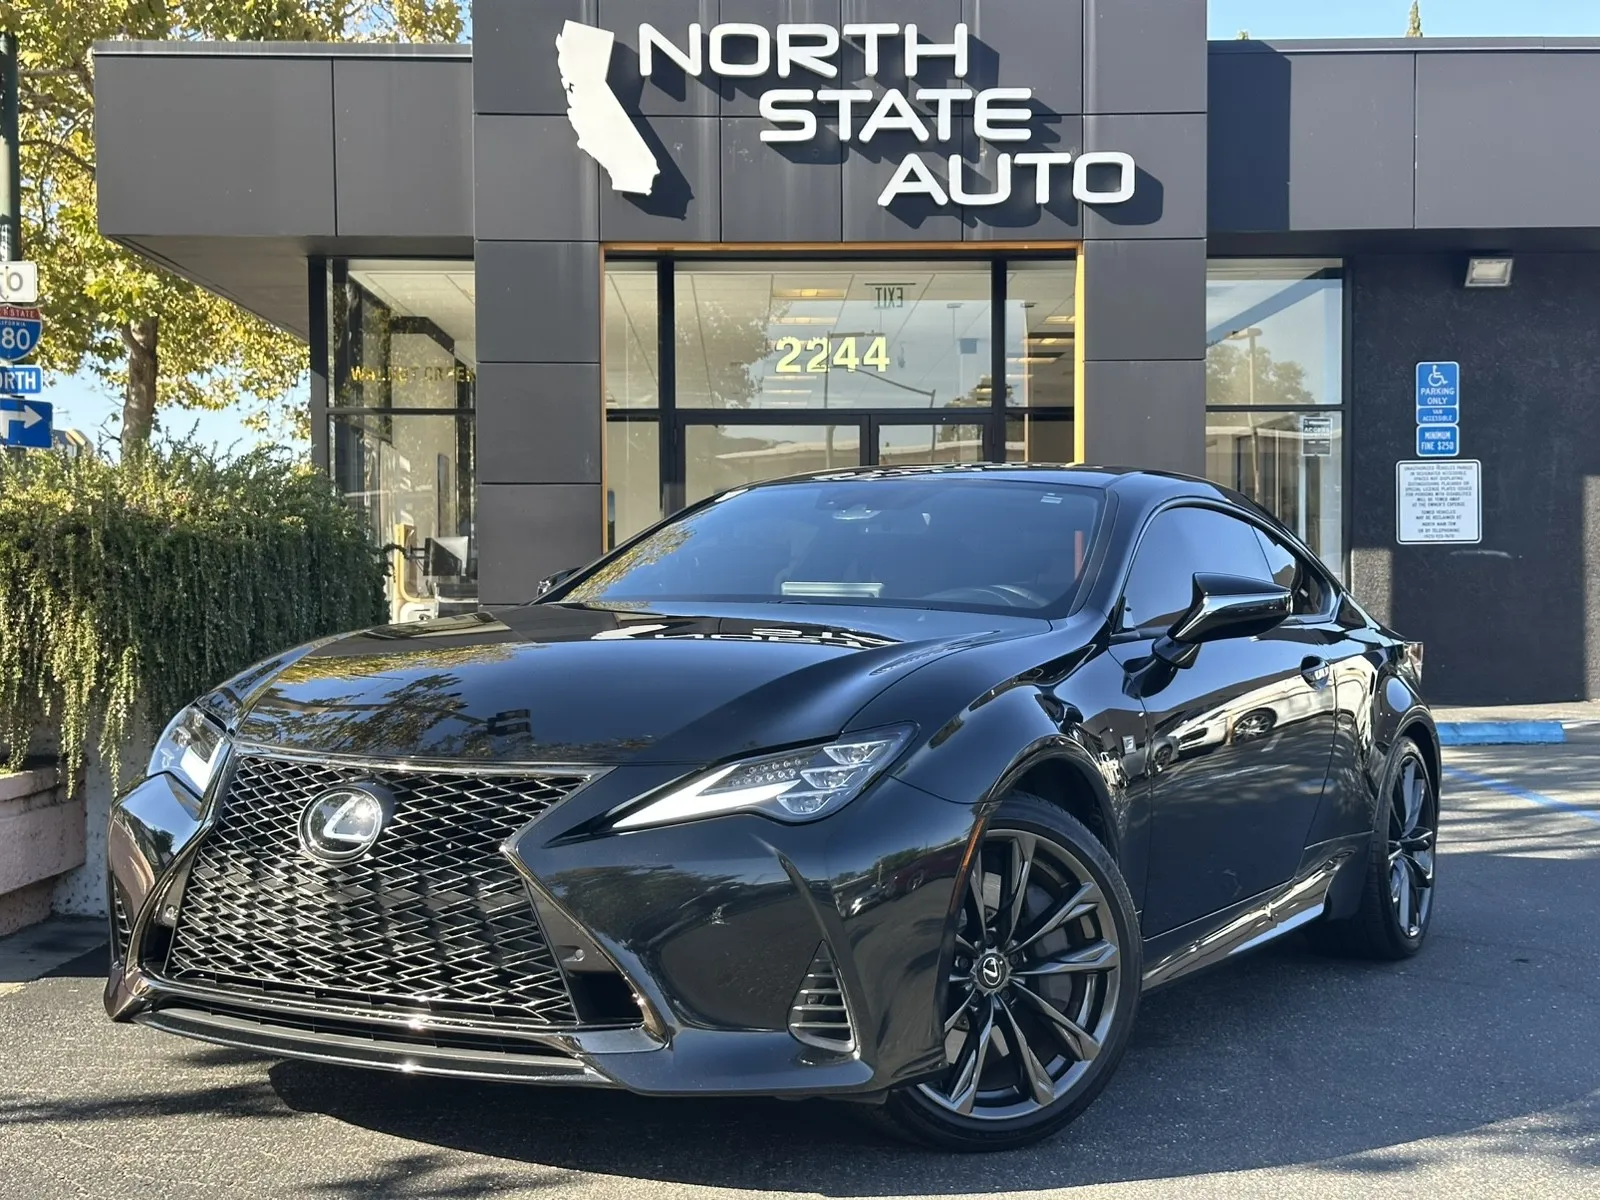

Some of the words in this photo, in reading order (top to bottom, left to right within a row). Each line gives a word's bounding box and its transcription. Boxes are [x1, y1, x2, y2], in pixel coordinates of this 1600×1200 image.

[638, 22, 968, 78] NORTH
[758, 87, 1032, 143] STATE
[877, 151, 1136, 207] AUTO
[775, 335, 890, 374] 2244
[1421, 441, 1435, 450] FINE
[1437, 441, 1454, 450] $250
[1424, 431, 1451, 440] MINIMUM
